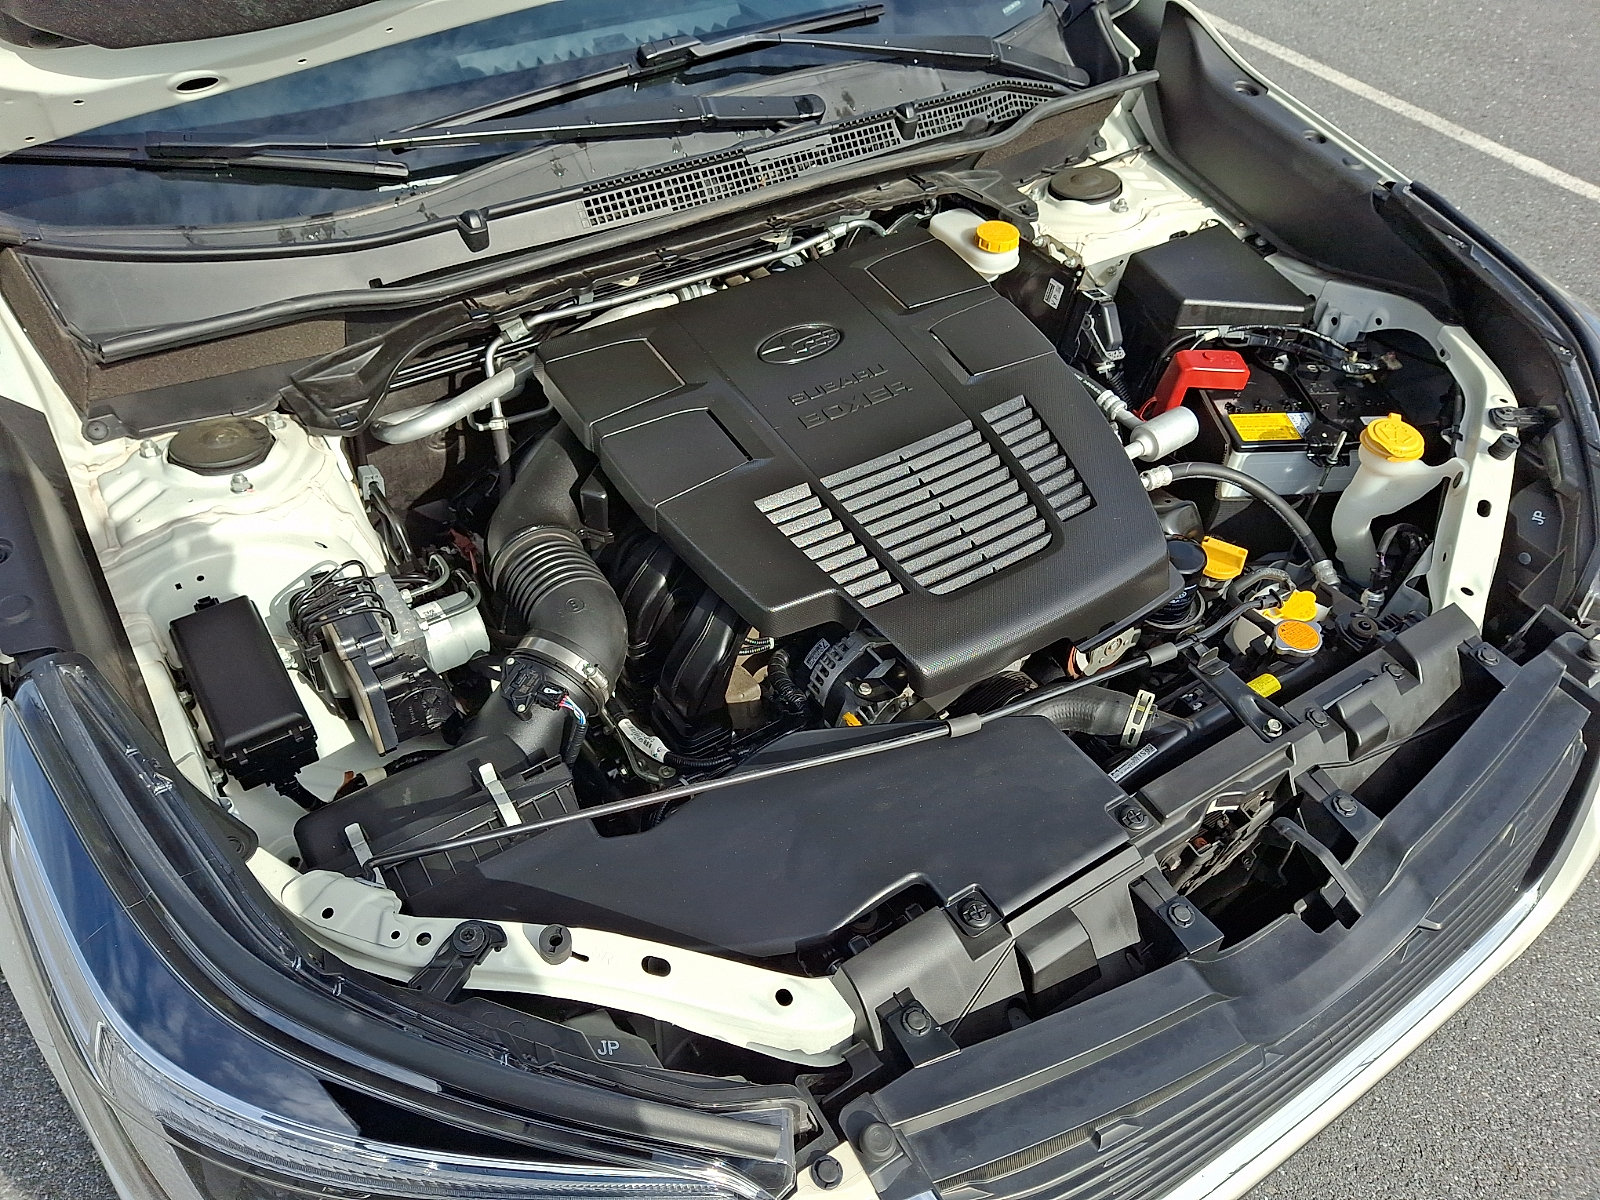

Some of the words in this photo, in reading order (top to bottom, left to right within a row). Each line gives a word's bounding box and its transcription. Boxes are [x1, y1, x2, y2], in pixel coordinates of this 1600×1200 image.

[787, 363, 889, 406] SUBARU
[797, 381, 914, 430] BOXER
[1531, 510, 1546, 526] JP
[597, 1039, 620, 1056] JP
